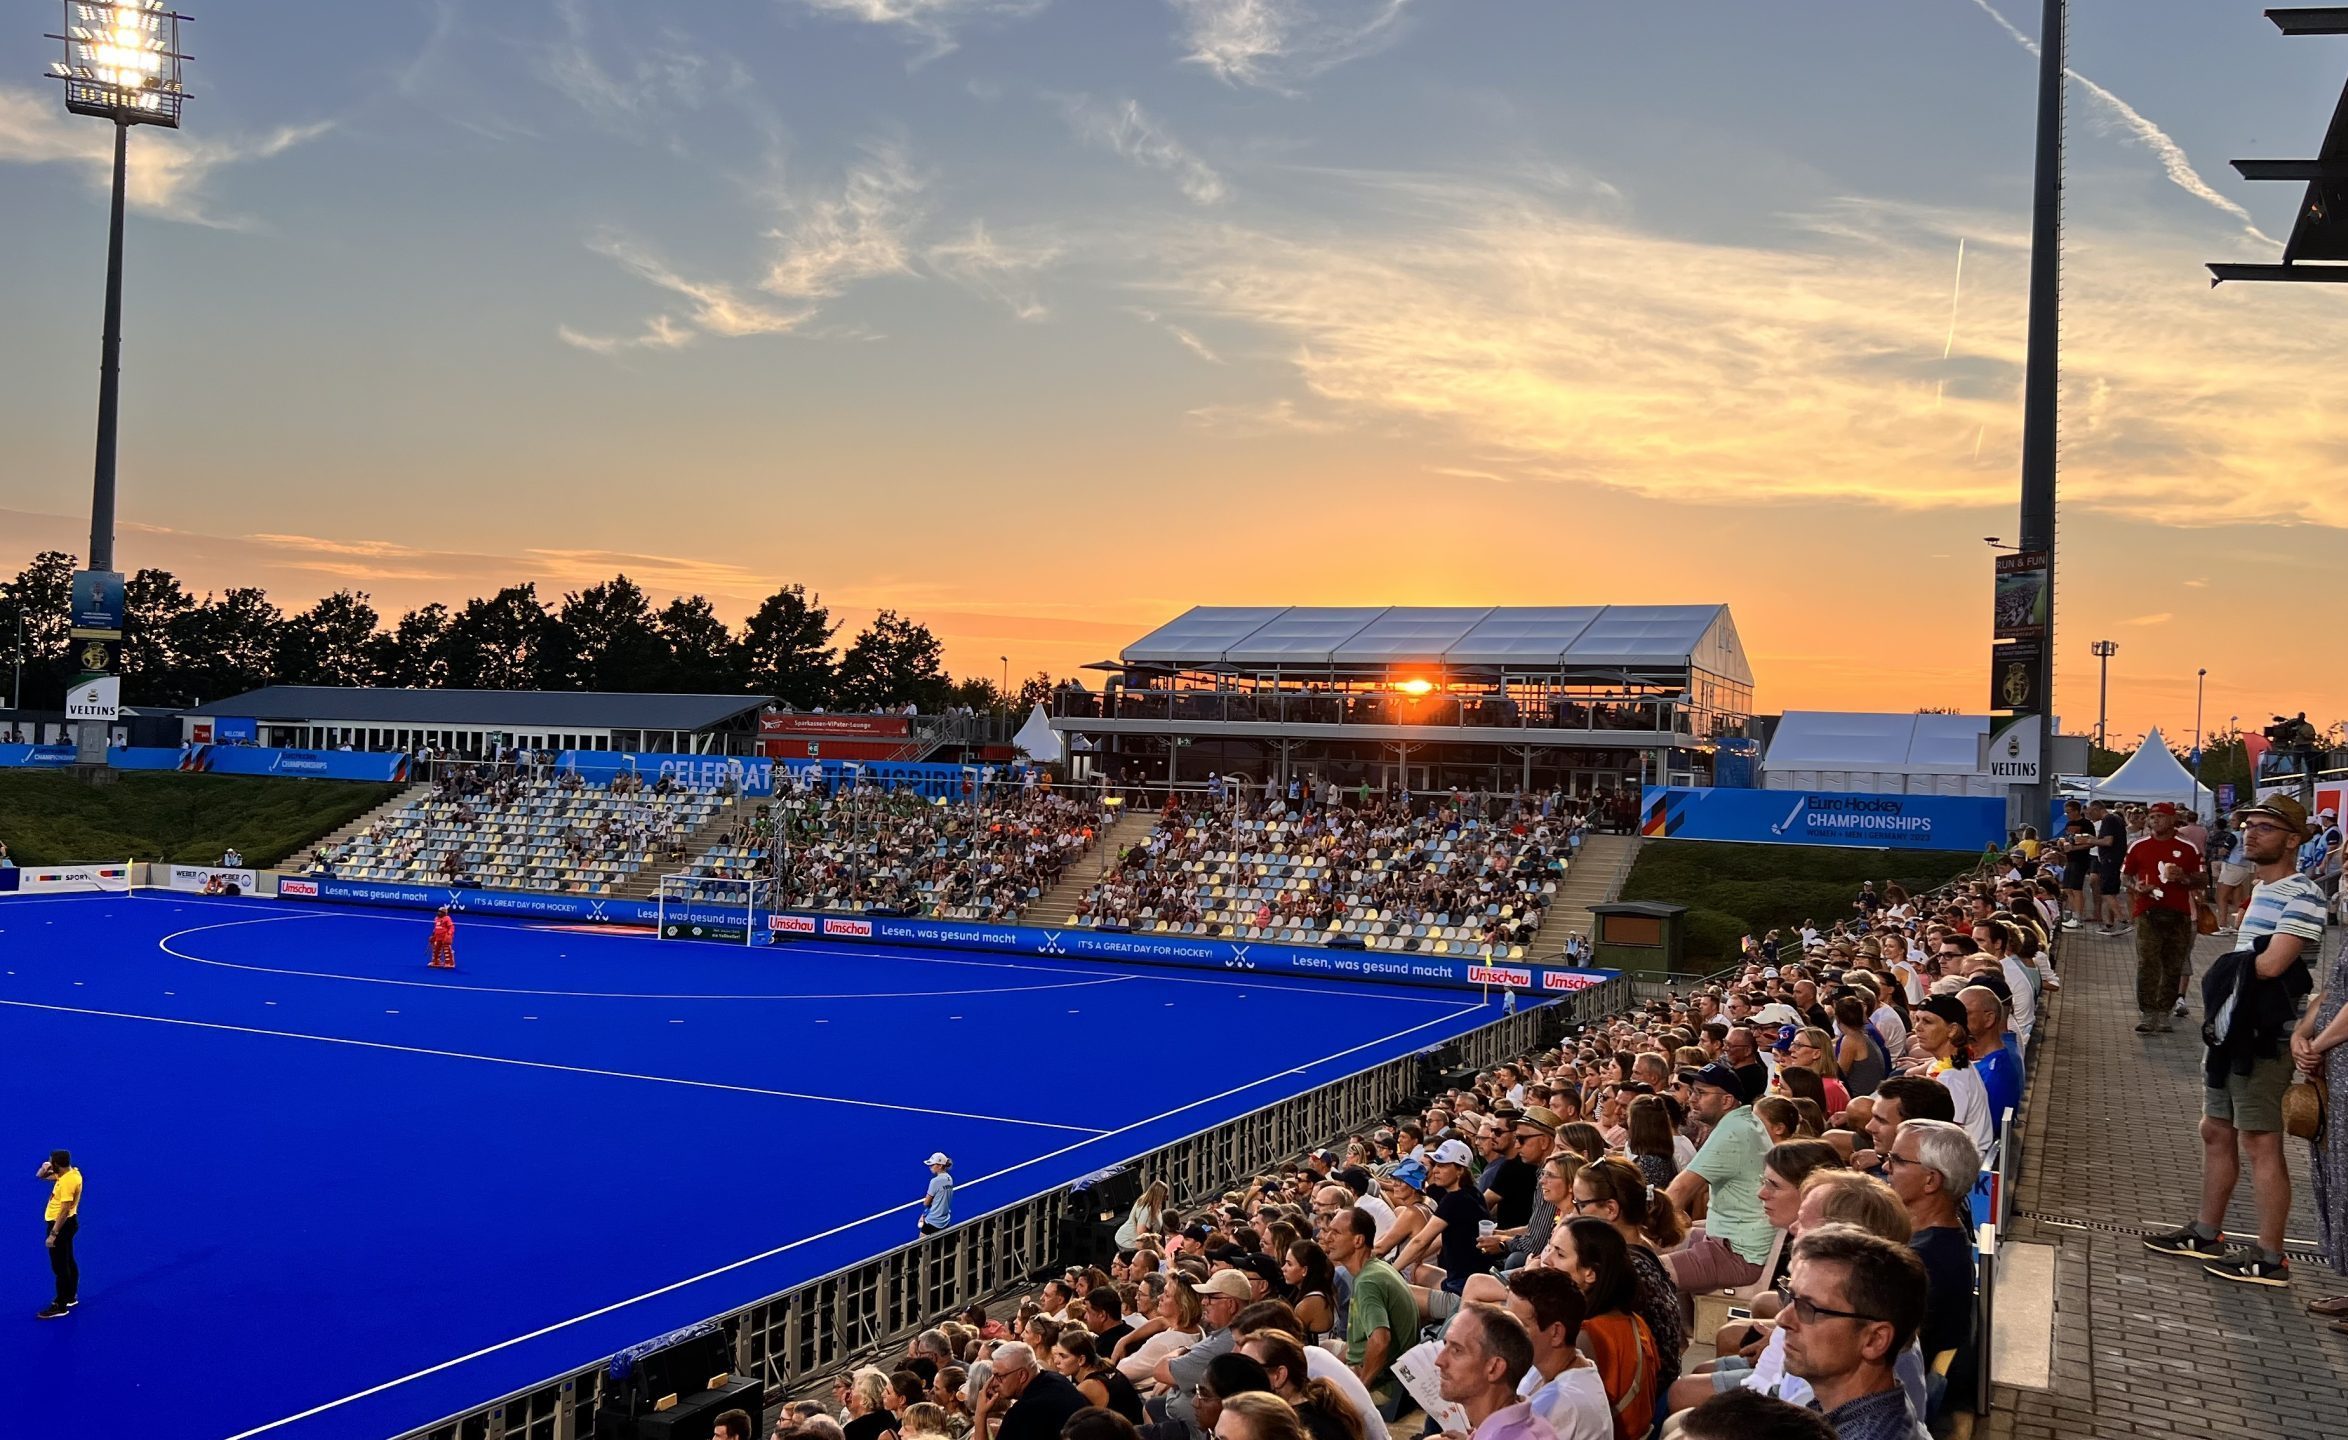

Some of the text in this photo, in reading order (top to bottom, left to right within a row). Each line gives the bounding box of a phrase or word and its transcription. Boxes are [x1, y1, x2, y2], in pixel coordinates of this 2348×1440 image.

[1997, 556, 2046, 568] RUN & FUN
[70, 705, 115, 716] VELTINS
[282, 760, 327, 769] CHAMPIONSHIPS
[1991, 762, 2036, 776] VELTINS
[1808, 796, 1903, 815] Euro Hockey
[1807, 813, 1931, 831] CHAMPIONSHIPS
[1807, 830, 1836, 838] WOMEN
[1869, 832, 1907, 840] GERMANY
[282, 880, 317, 895] Umschau
[325, 886, 351, 897] Lesen,
[370, 890, 400, 900] gesund
[402, 893, 428, 902] macht
[474, 898, 487, 906] IT'S
[494, 900, 516, 908] GREAT
[516, 901, 531, 910] DAY
[532, 902, 546, 911] FOR
[546, 903, 578, 912] HOCKEY!
[669, 912, 688, 921] was
[690, 914, 724, 924] gesund
[770, 916, 814, 931] Umschau
[825, 919, 870, 935] Umschau
[882, 925, 1016, 944] Lesen, was gesund macht
[1078, 940, 1213, 958] IT'S A GREAT DAY FOR HOCKEY!
[1292, 954, 1453, 978] Lesen, was gesund macht
[1470, 967, 1528, 985] Umschau
